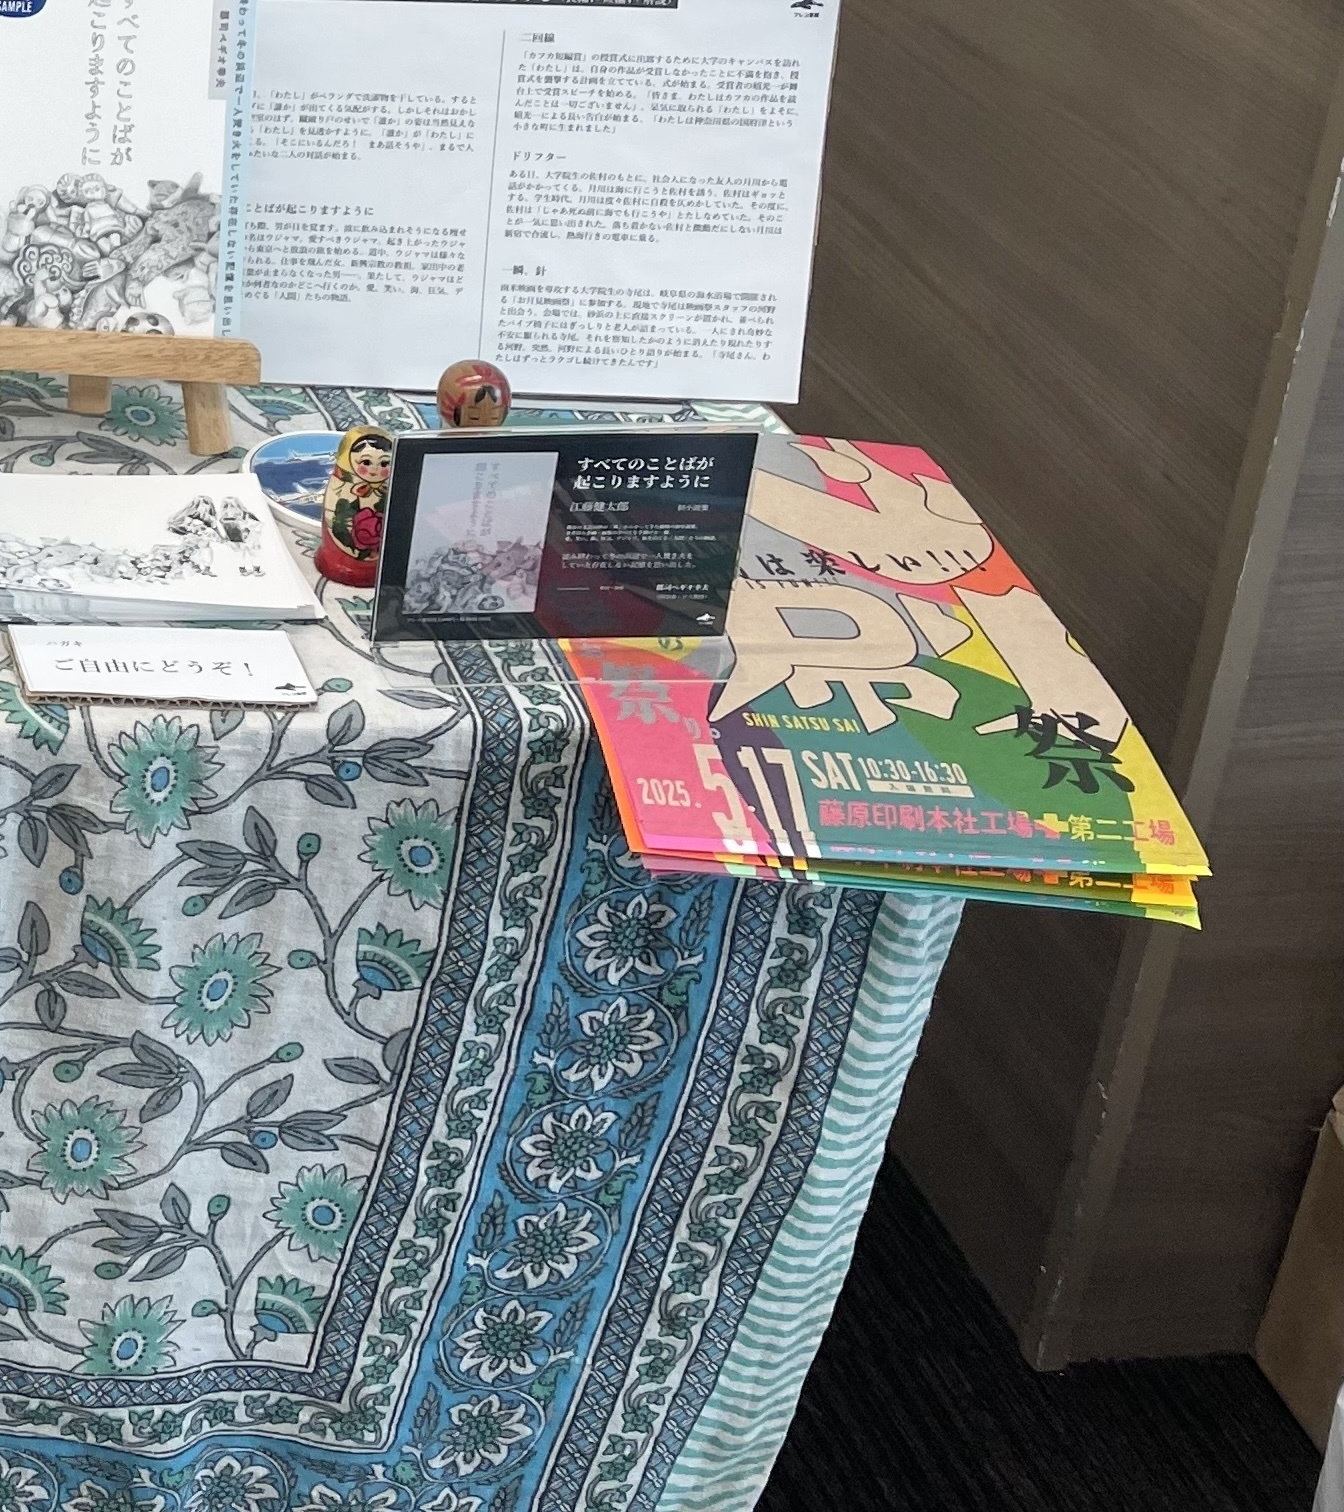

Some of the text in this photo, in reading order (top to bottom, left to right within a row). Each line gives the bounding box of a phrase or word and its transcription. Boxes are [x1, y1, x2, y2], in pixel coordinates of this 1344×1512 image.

[512, 151, 567, 162] ドリフター
[577, 456, 716, 472] すべてのことばが
[572, 474, 710, 490] 起こりますように
[55, 657, 255, 677] ご自由にどうぞ！
[742, 711, 862, 734] SHIN SATSU SAI
[1014, 705, 1135, 794] 祭
[801, 750, 862, 792] SAT
[858, 756, 969, 785] 10:30-16:30
